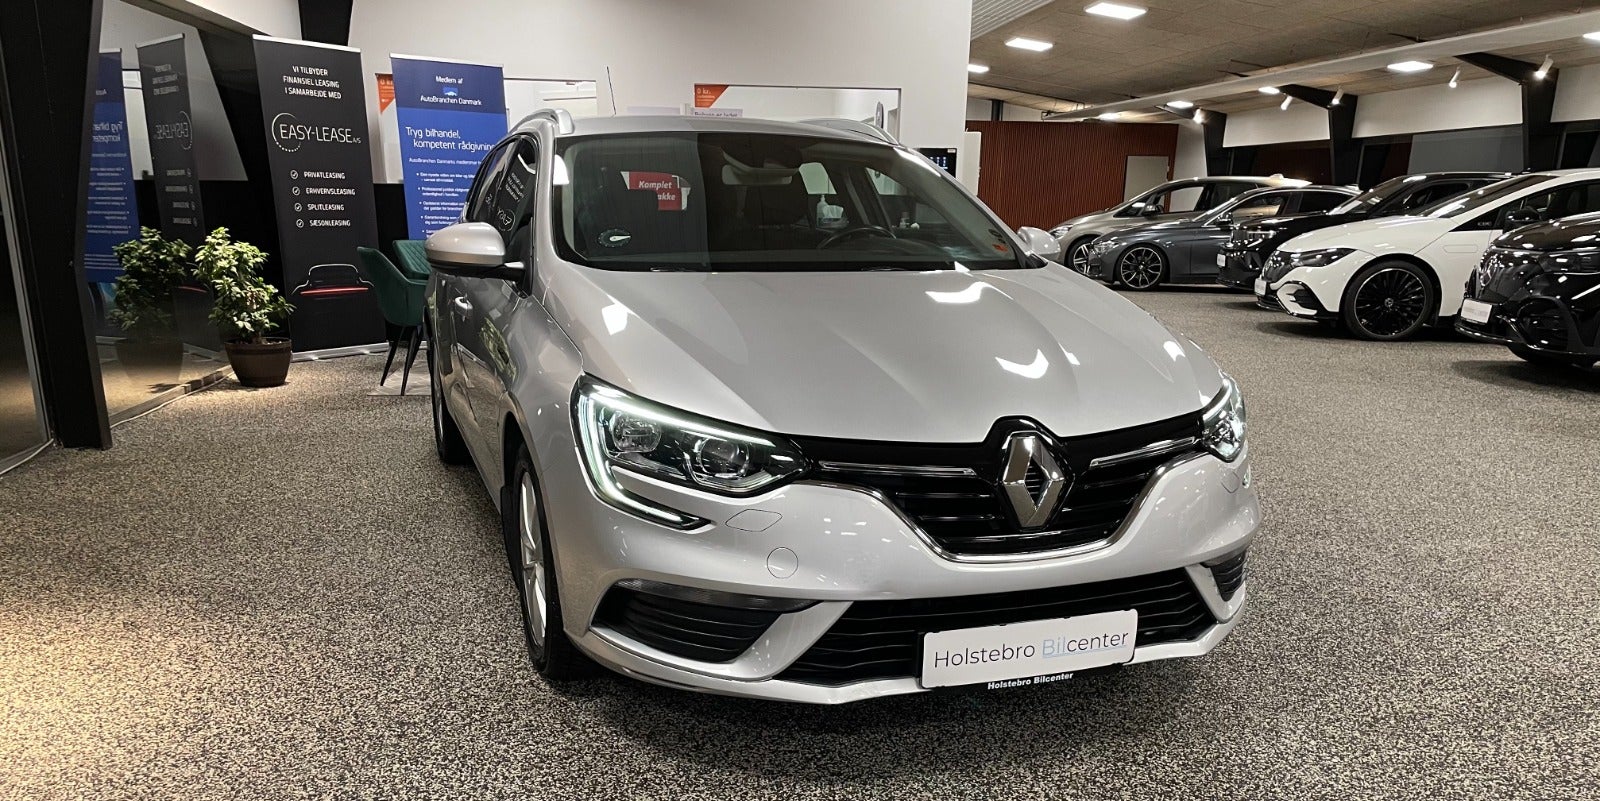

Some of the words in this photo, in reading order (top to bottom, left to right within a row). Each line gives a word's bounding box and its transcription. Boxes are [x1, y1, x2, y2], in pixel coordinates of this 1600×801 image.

[292, 65, 299, 73] VI
[300, 66, 328, 76] TILBYDER
[282, 75, 315, 86] FINANSIEL
[315, 79, 340, 88] LEASING
[435, 75, 457, 84] Medlem
[288, 87, 327, 98] SAMARBEJDE
[327, 91, 342, 99] MED
[420, 95, 458, 104] AutoBranchen
[279, 124, 353, 143] EASY-LEASE
[405, 126, 423, 138] Tryg
[425, 128, 461, 139] bilhandel,
[413, 139, 456, 150] kompetent
[303, 171, 346, 179] PRIVATLEASING
[305, 187, 356, 195] ERHVERVSLEASING
[638, 180, 673, 191] Komplet
[307, 203, 345, 211] SPLITLEASING
[309, 219, 351, 227] SÆSONLEASING
[934, 643, 1036, 669] Holstebro
[1042, 631, 1129, 657] Bilcenter
[987, 678, 1032, 690] Holstebro
[1033, 672, 1074, 684] Bilcenter
